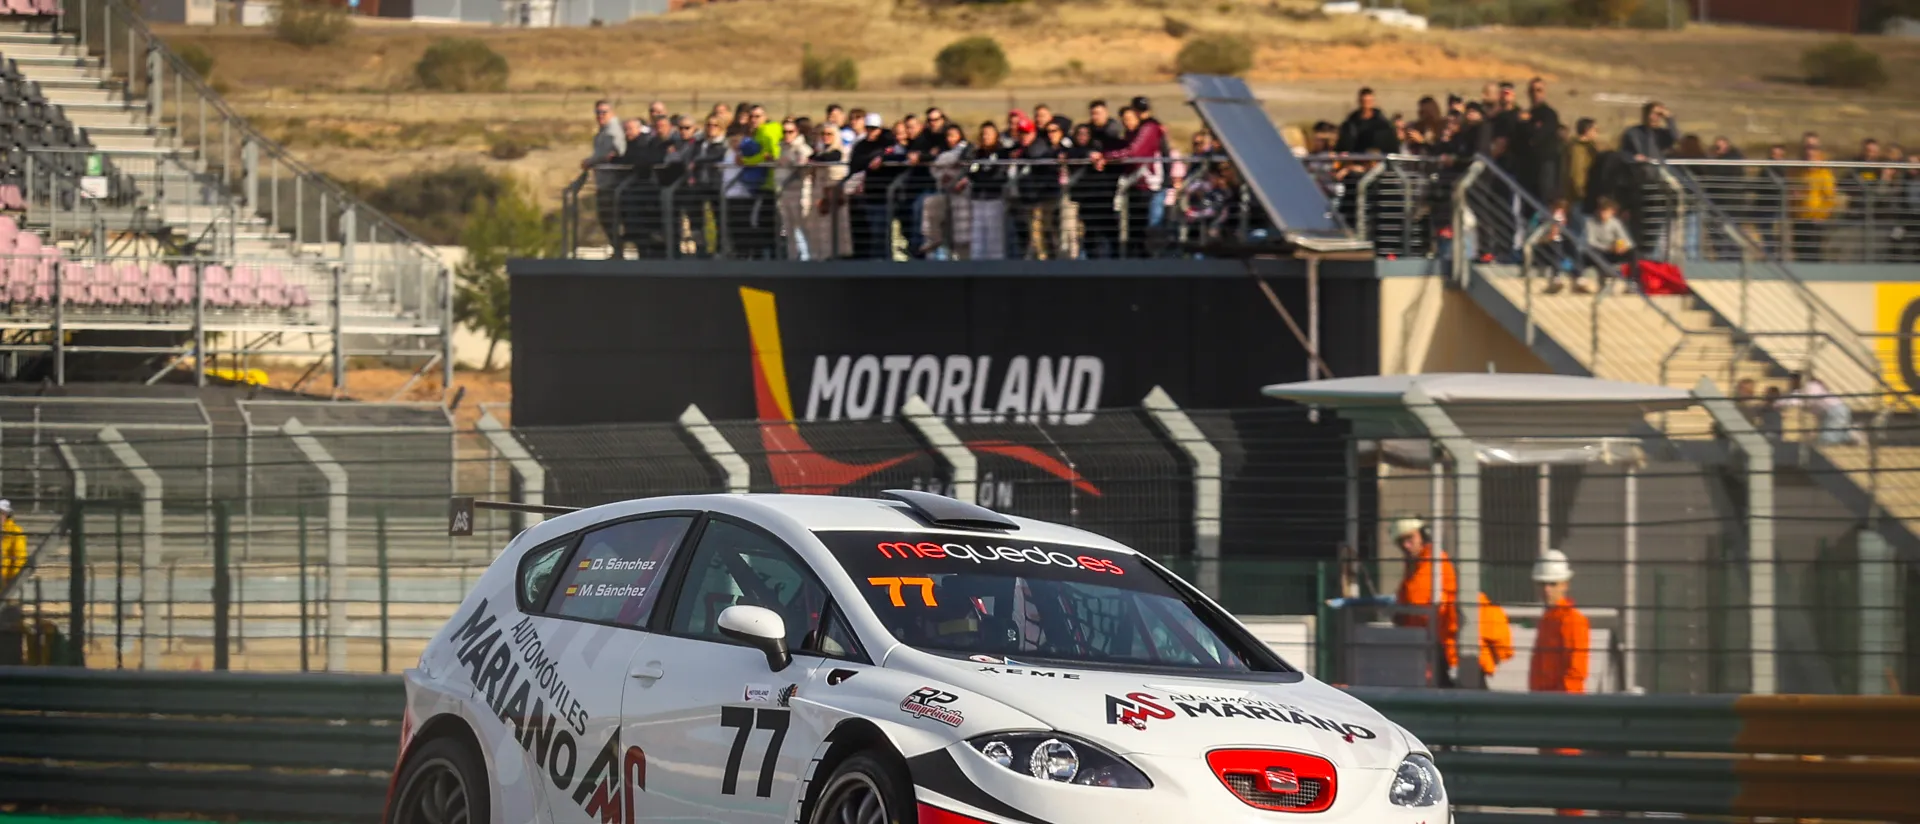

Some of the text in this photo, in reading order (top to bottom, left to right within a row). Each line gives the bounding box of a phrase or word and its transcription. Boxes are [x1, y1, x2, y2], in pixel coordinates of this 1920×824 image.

[805, 354, 1105, 426] MOTORLAND
[591, 557, 657, 570] D. Sánchez
[877, 541, 1124, 575] mequedo.es
[578, 583, 646, 597] M. Sánchez
[867, 577, 938, 607] 77
[450, 597, 577, 791] MARIANO
[510, 616, 589, 736] AUTOMÓVILES
[1174, 701, 1376, 739] MARIANO
[721, 706, 791, 798] 77
